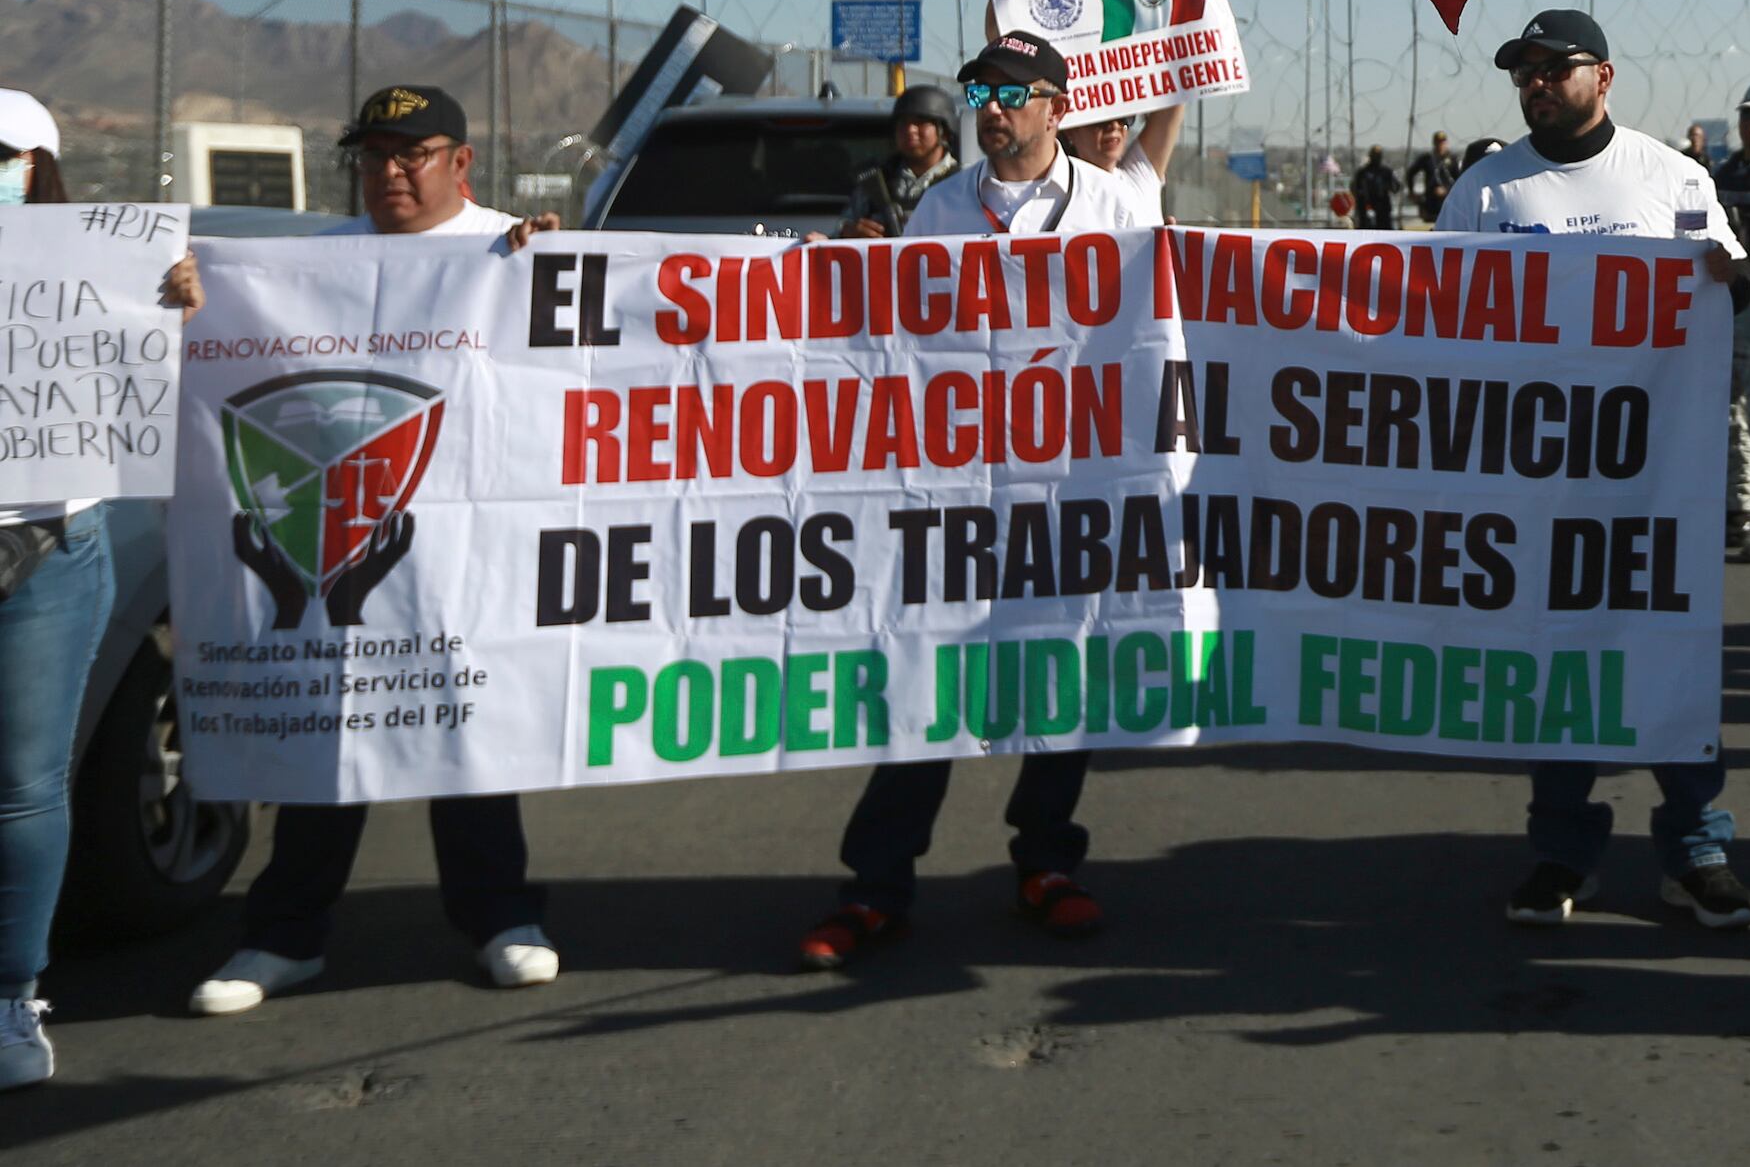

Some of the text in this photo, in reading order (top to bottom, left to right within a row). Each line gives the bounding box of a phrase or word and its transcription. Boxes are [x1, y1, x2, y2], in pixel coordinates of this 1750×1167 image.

[1120, 76, 1147, 102] DE
[1150, 69, 1178, 96] LA
[79, 204, 180, 242] #PJF
[1566, 214, 1601, 227] El PJF
[529, 228, 1694, 348] EL SINDICATO NACIONAL DE
[0, 323, 169, 374] PUEBLO
[186, 330, 487, 361] RENOVACION SINDICAL
[75, 372, 171, 418] PAZ
[561, 348, 1650, 485] RENOVACIÓN AL SERVICIO
[536, 493, 1690, 627] DE LOS TRABAJADORES DEL
[198, 631, 464, 664] Sindicato Nacional de
[182, 666, 488, 699] Renovación al Servicio de
[587, 630, 1637, 767] PODER JUDICIAL FEDERAL
[190, 702, 476, 740] los Trabajadores del PJF
